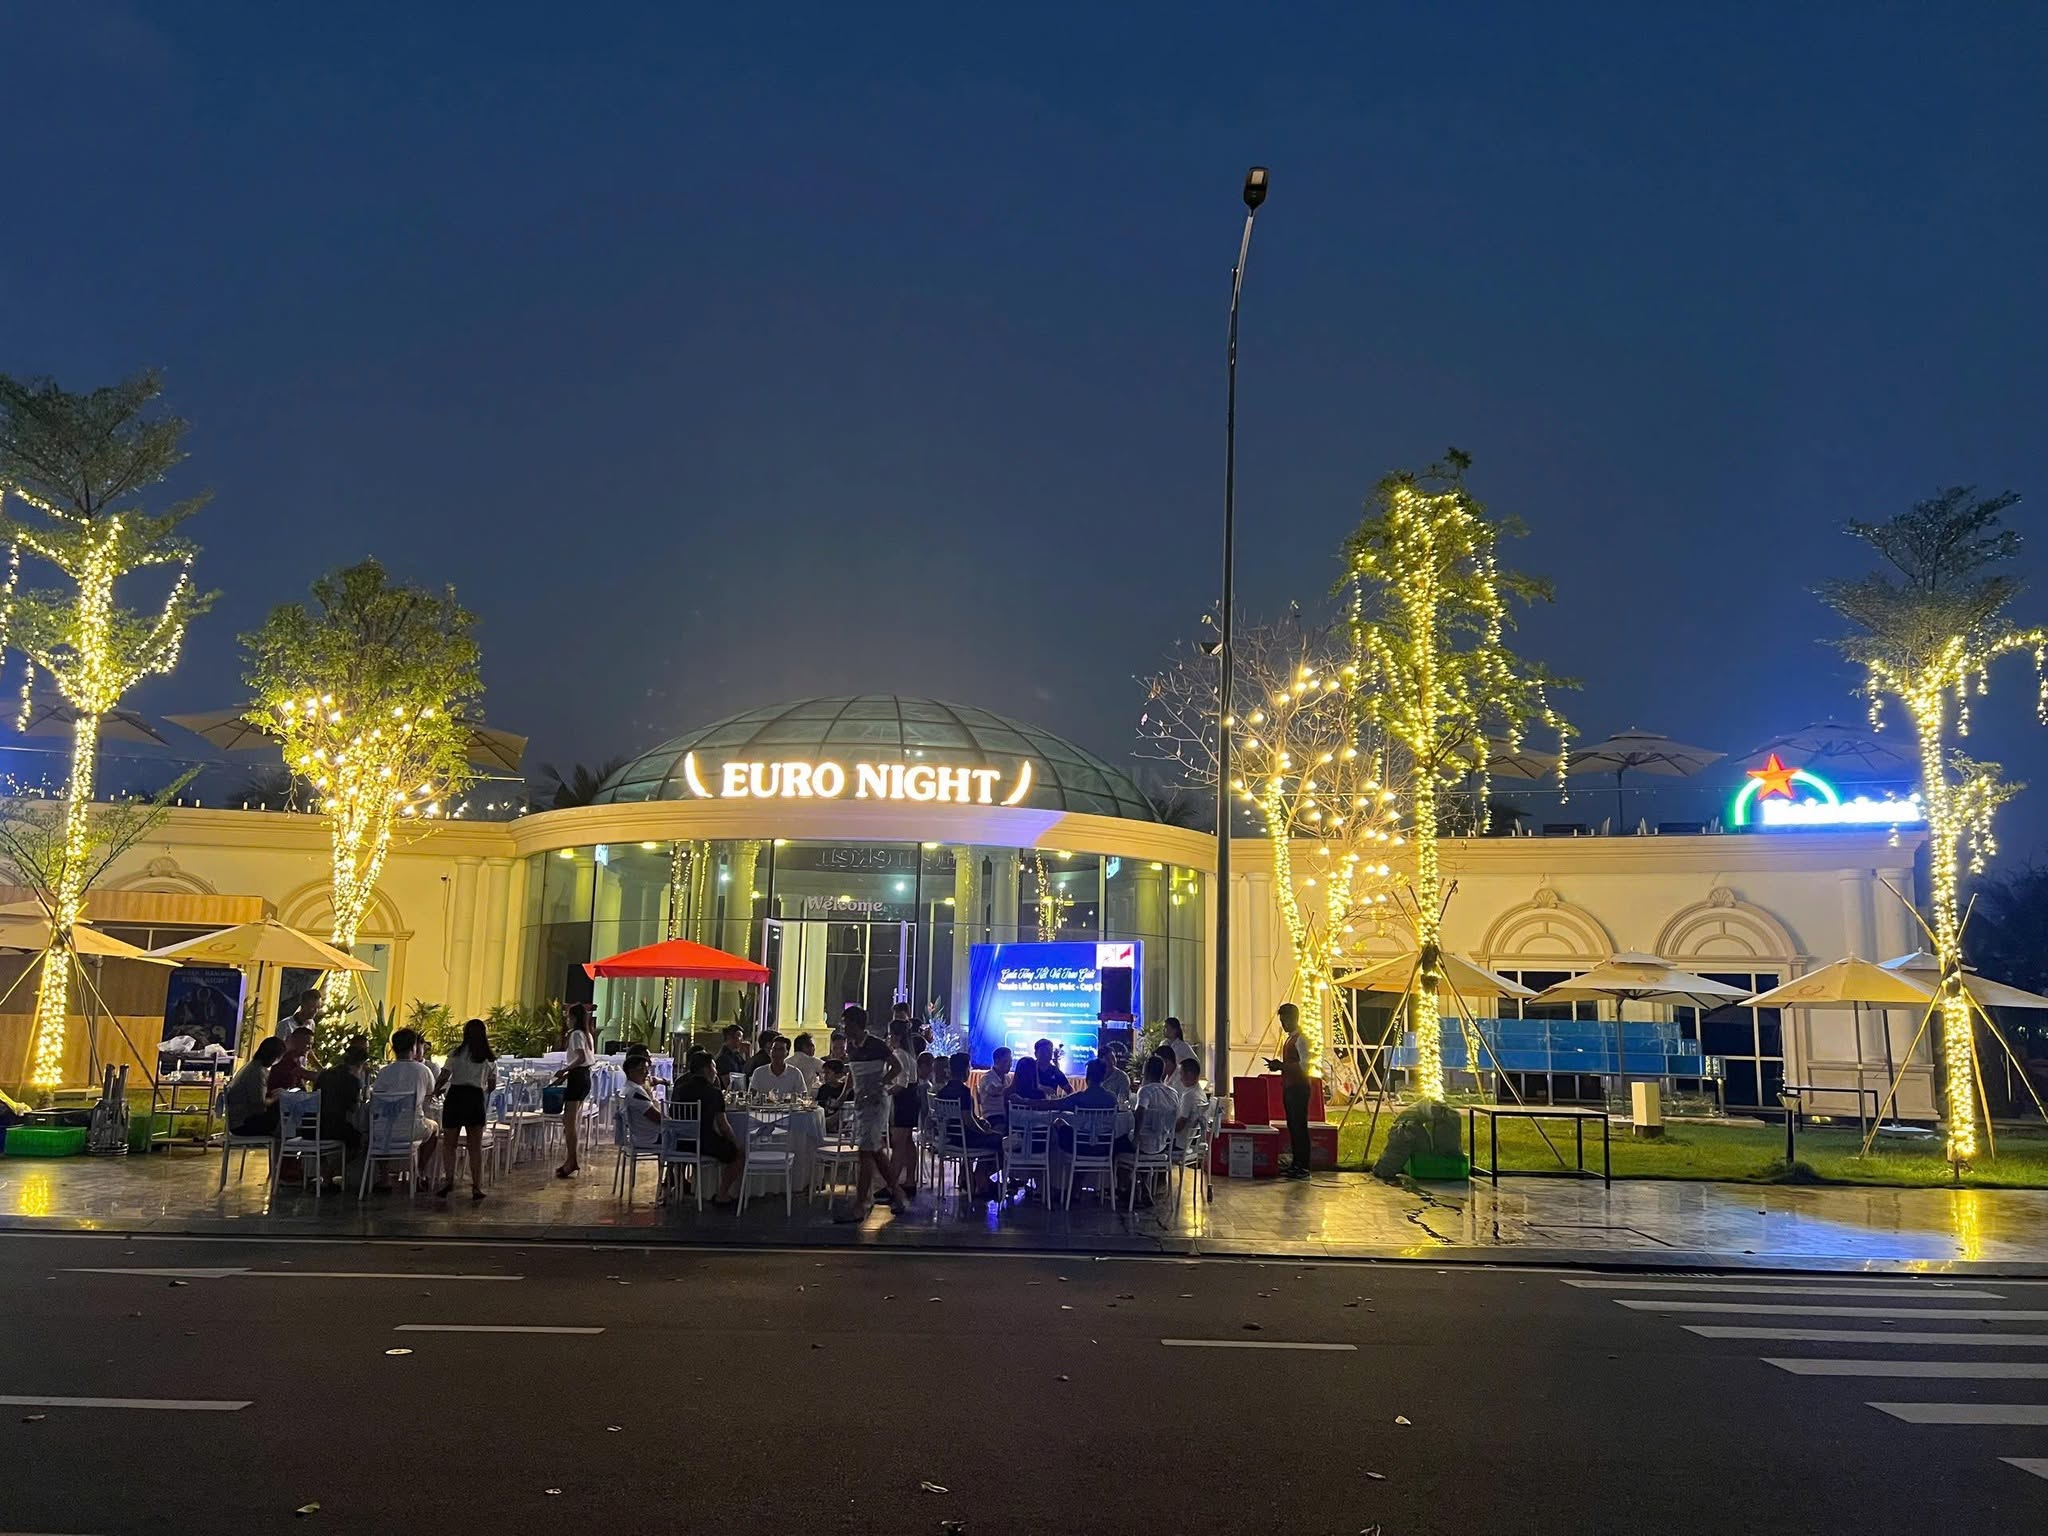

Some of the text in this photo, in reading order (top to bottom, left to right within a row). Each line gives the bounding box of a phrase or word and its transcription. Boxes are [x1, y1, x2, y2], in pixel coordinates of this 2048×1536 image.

[721, 762, 1001, 804] EURO NIGHT
[806, 896, 883, 913] Welcome
